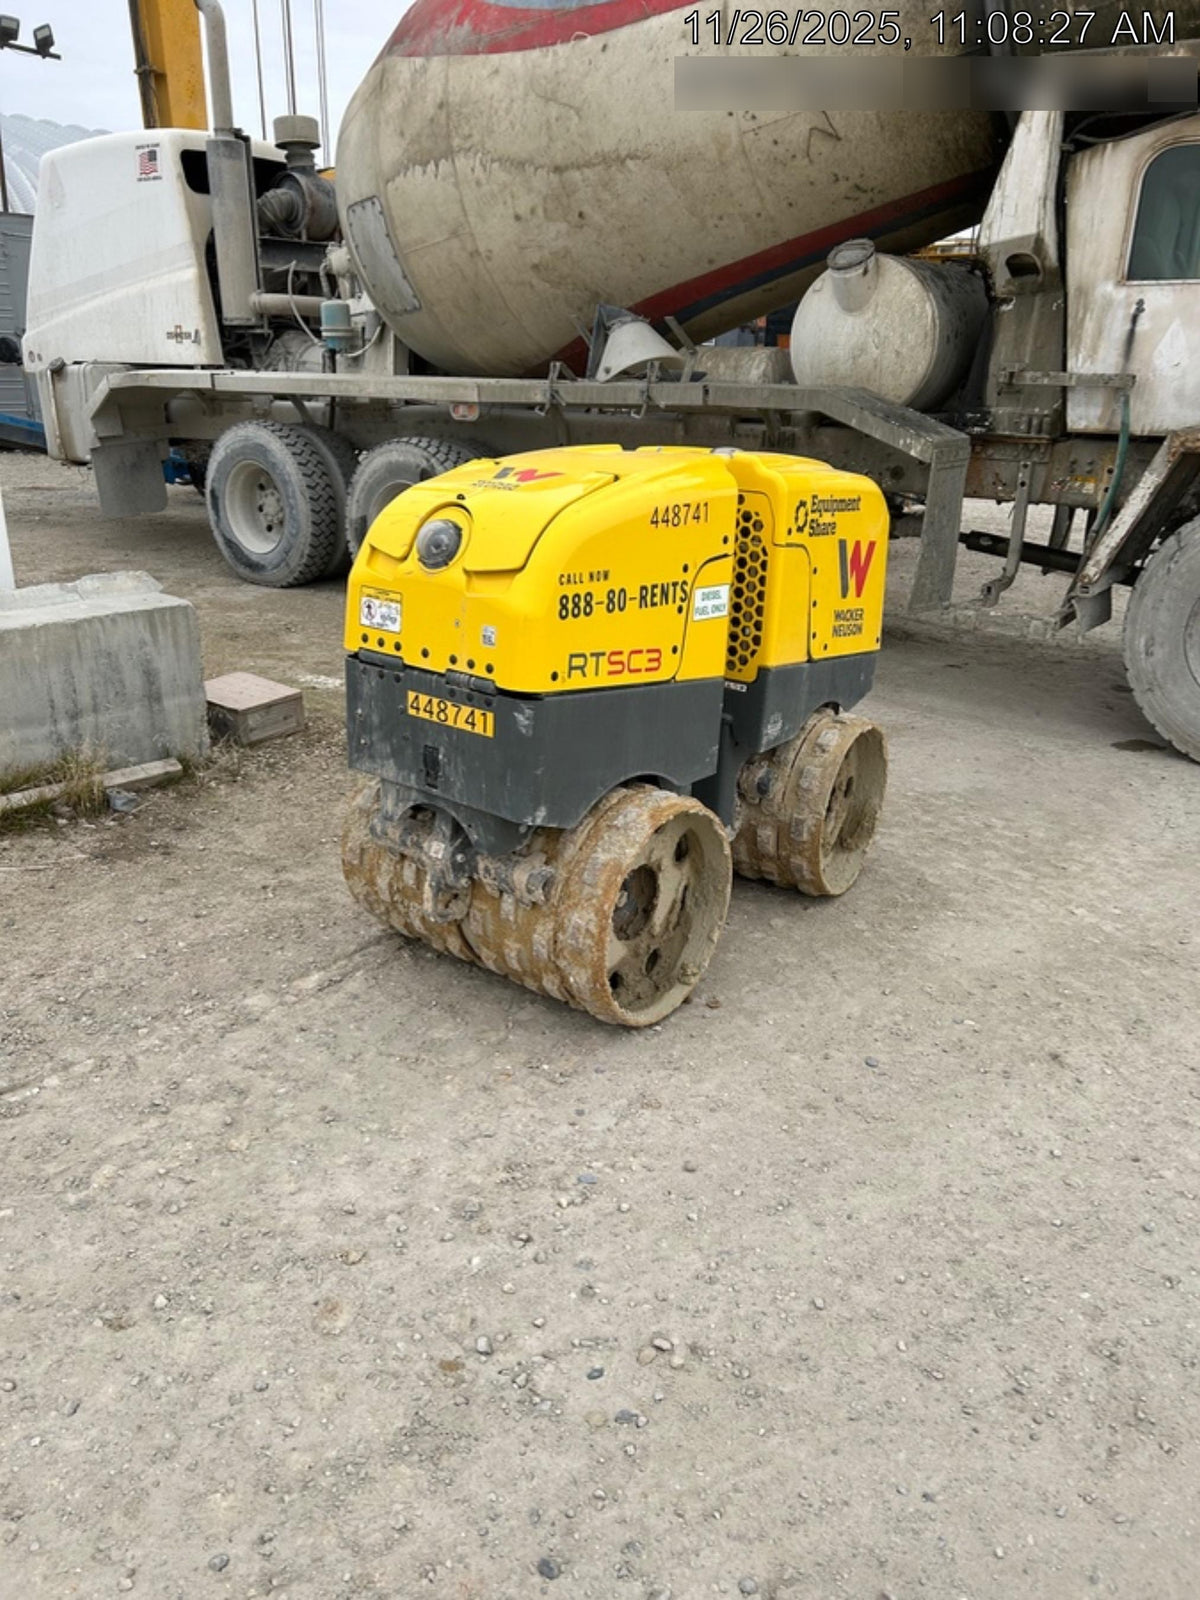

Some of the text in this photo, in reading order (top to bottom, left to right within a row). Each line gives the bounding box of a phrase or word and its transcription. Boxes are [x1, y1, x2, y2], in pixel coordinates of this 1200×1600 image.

[809, 494, 861, 515] Equipment
[650, 502, 710, 528] 448741
[808, 518, 837, 538] Share
[558, 569, 610, 586] CALL NOW
[558, 580, 690, 621] 888-80-RENTS
[701, 589, 722, 602] DIESEL
[710, 602, 727, 615] ONLY
[833, 608, 865, 622] WACKER
[832, 622, 863, 639] NEUSON
[567, 647, 663, 680] RTSC3
[409, 693, 490, 734] 448741
